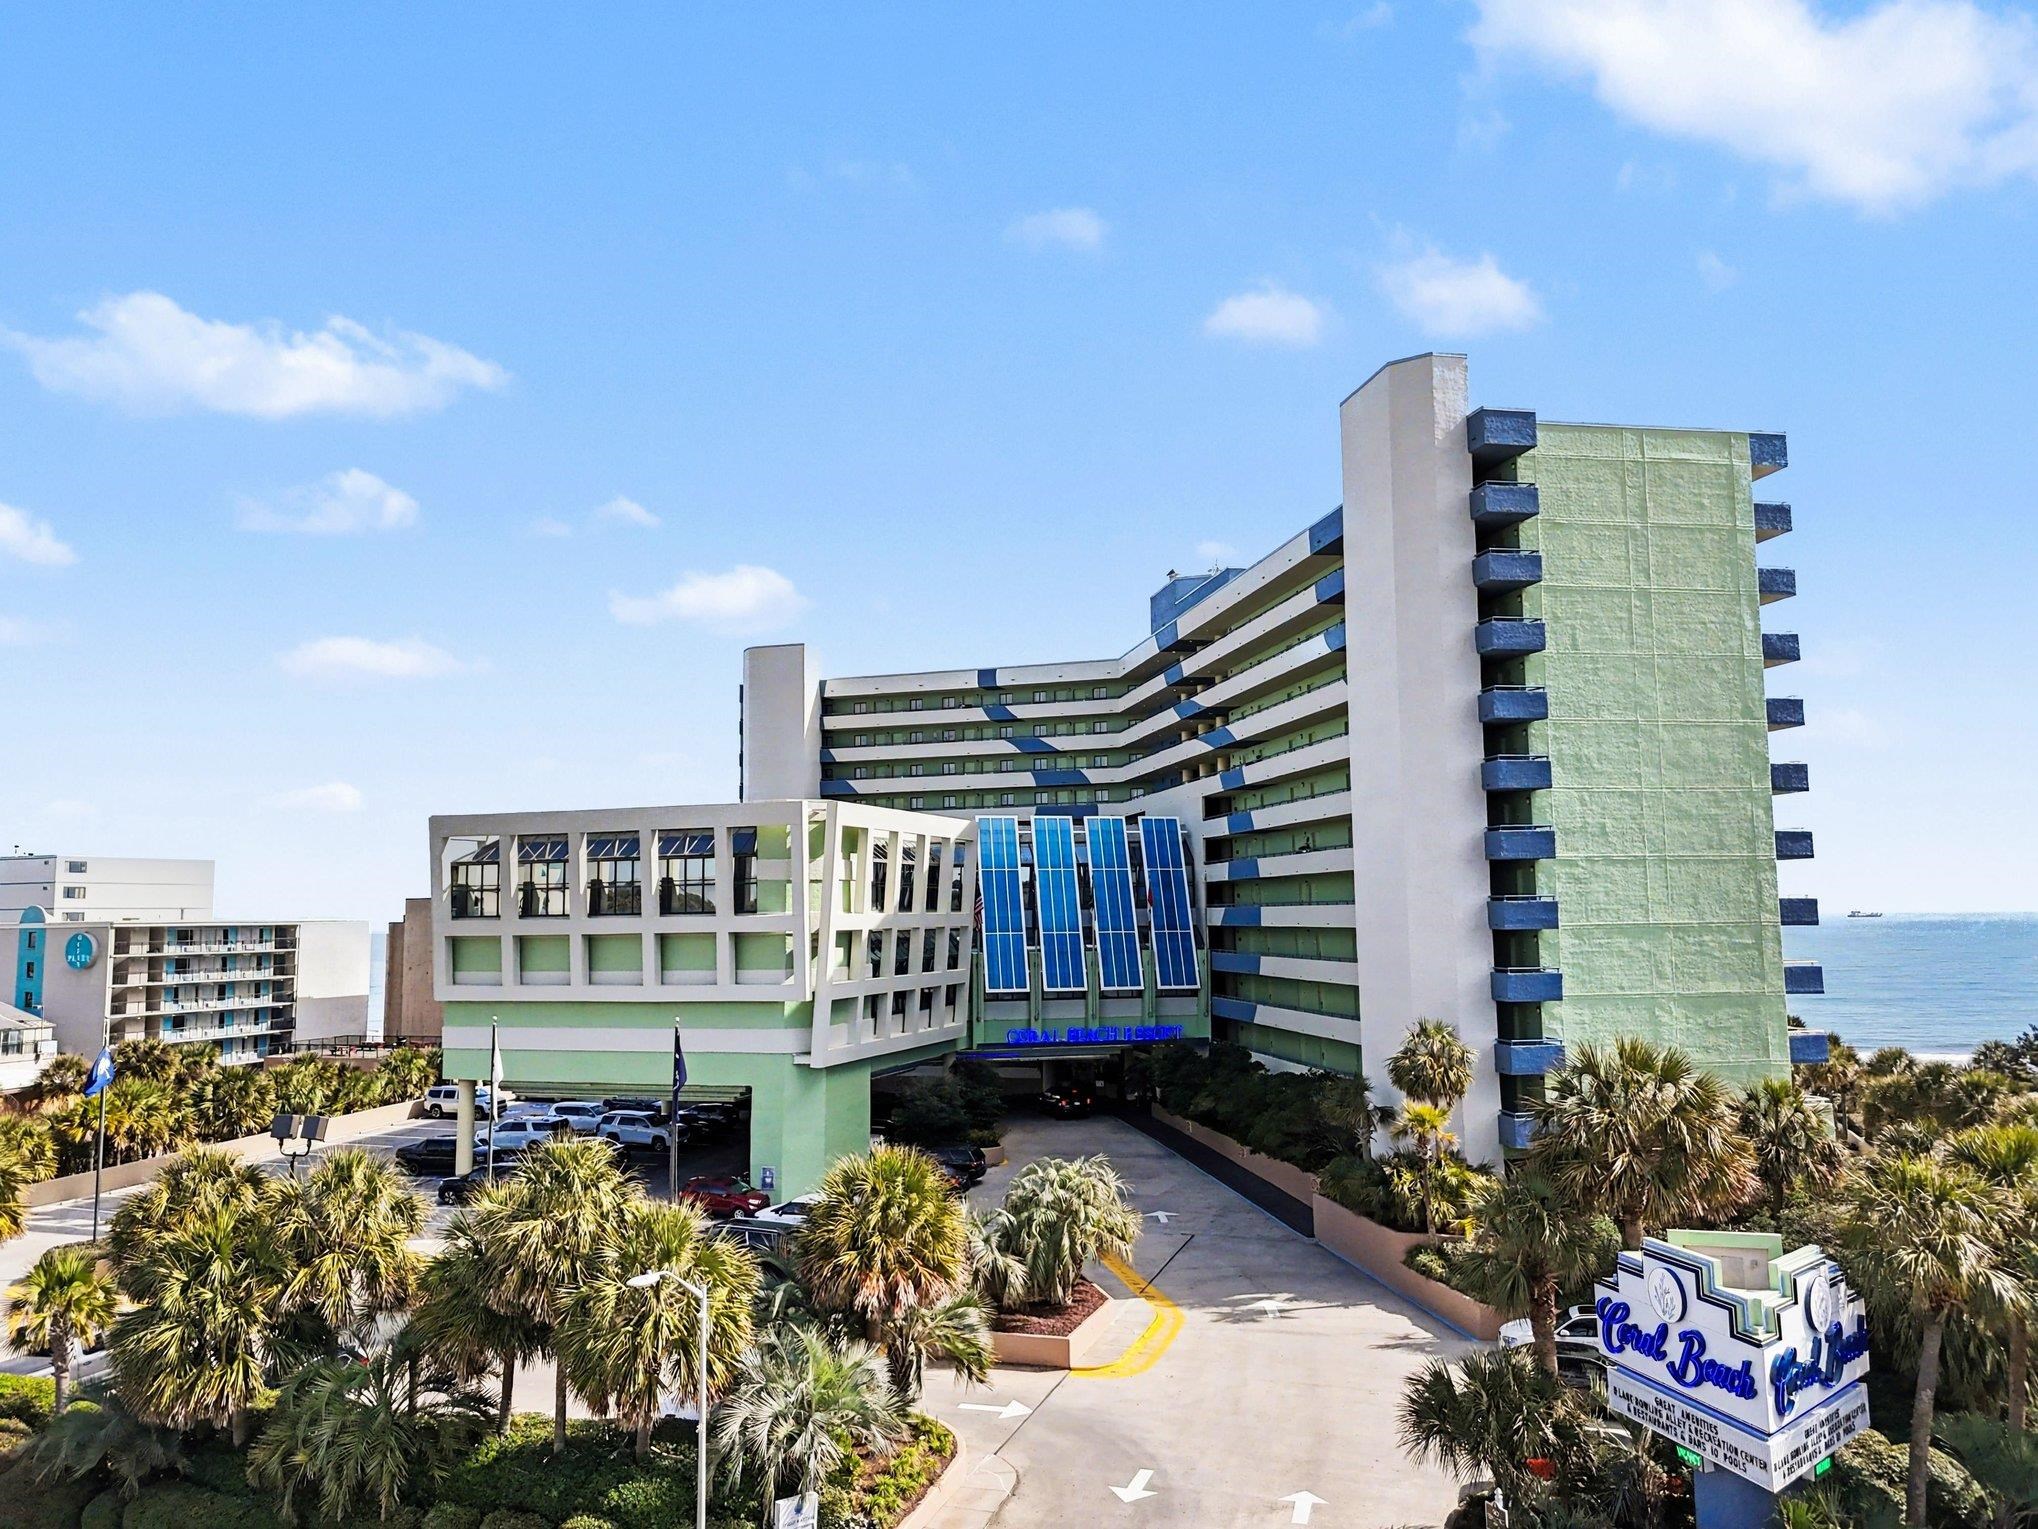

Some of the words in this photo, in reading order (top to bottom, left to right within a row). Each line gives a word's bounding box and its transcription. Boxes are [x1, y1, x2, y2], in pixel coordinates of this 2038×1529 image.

[1007, 1028, 1066, 1043] CORAL
[1067, 1026, 1119, 1042] BEACH
[1123, 1025, 1183, 1041] RESORT
[1596, 1296, 1669, 1362] Coral
[1666, 1329, 1758, 1400] Beach
[1633, 1405, 1678, 1437] RESTAURANTS
[1688, 1434, 1707, 1452] BARS
[1723, 1452, 1747, 1473] POOLS
[1634, 1396, 1663, 1419] BOWLING
[1665, 1413, 1686, 1429] ALLEY
[1694, 1426, 1739, 1457] RECREATION
[1740, 1450, 1768, 1472] CENTER
[1654, 1396, 1676, 1414] GREAT
[1681, 1409, 1719, 1436] AMENITIES
